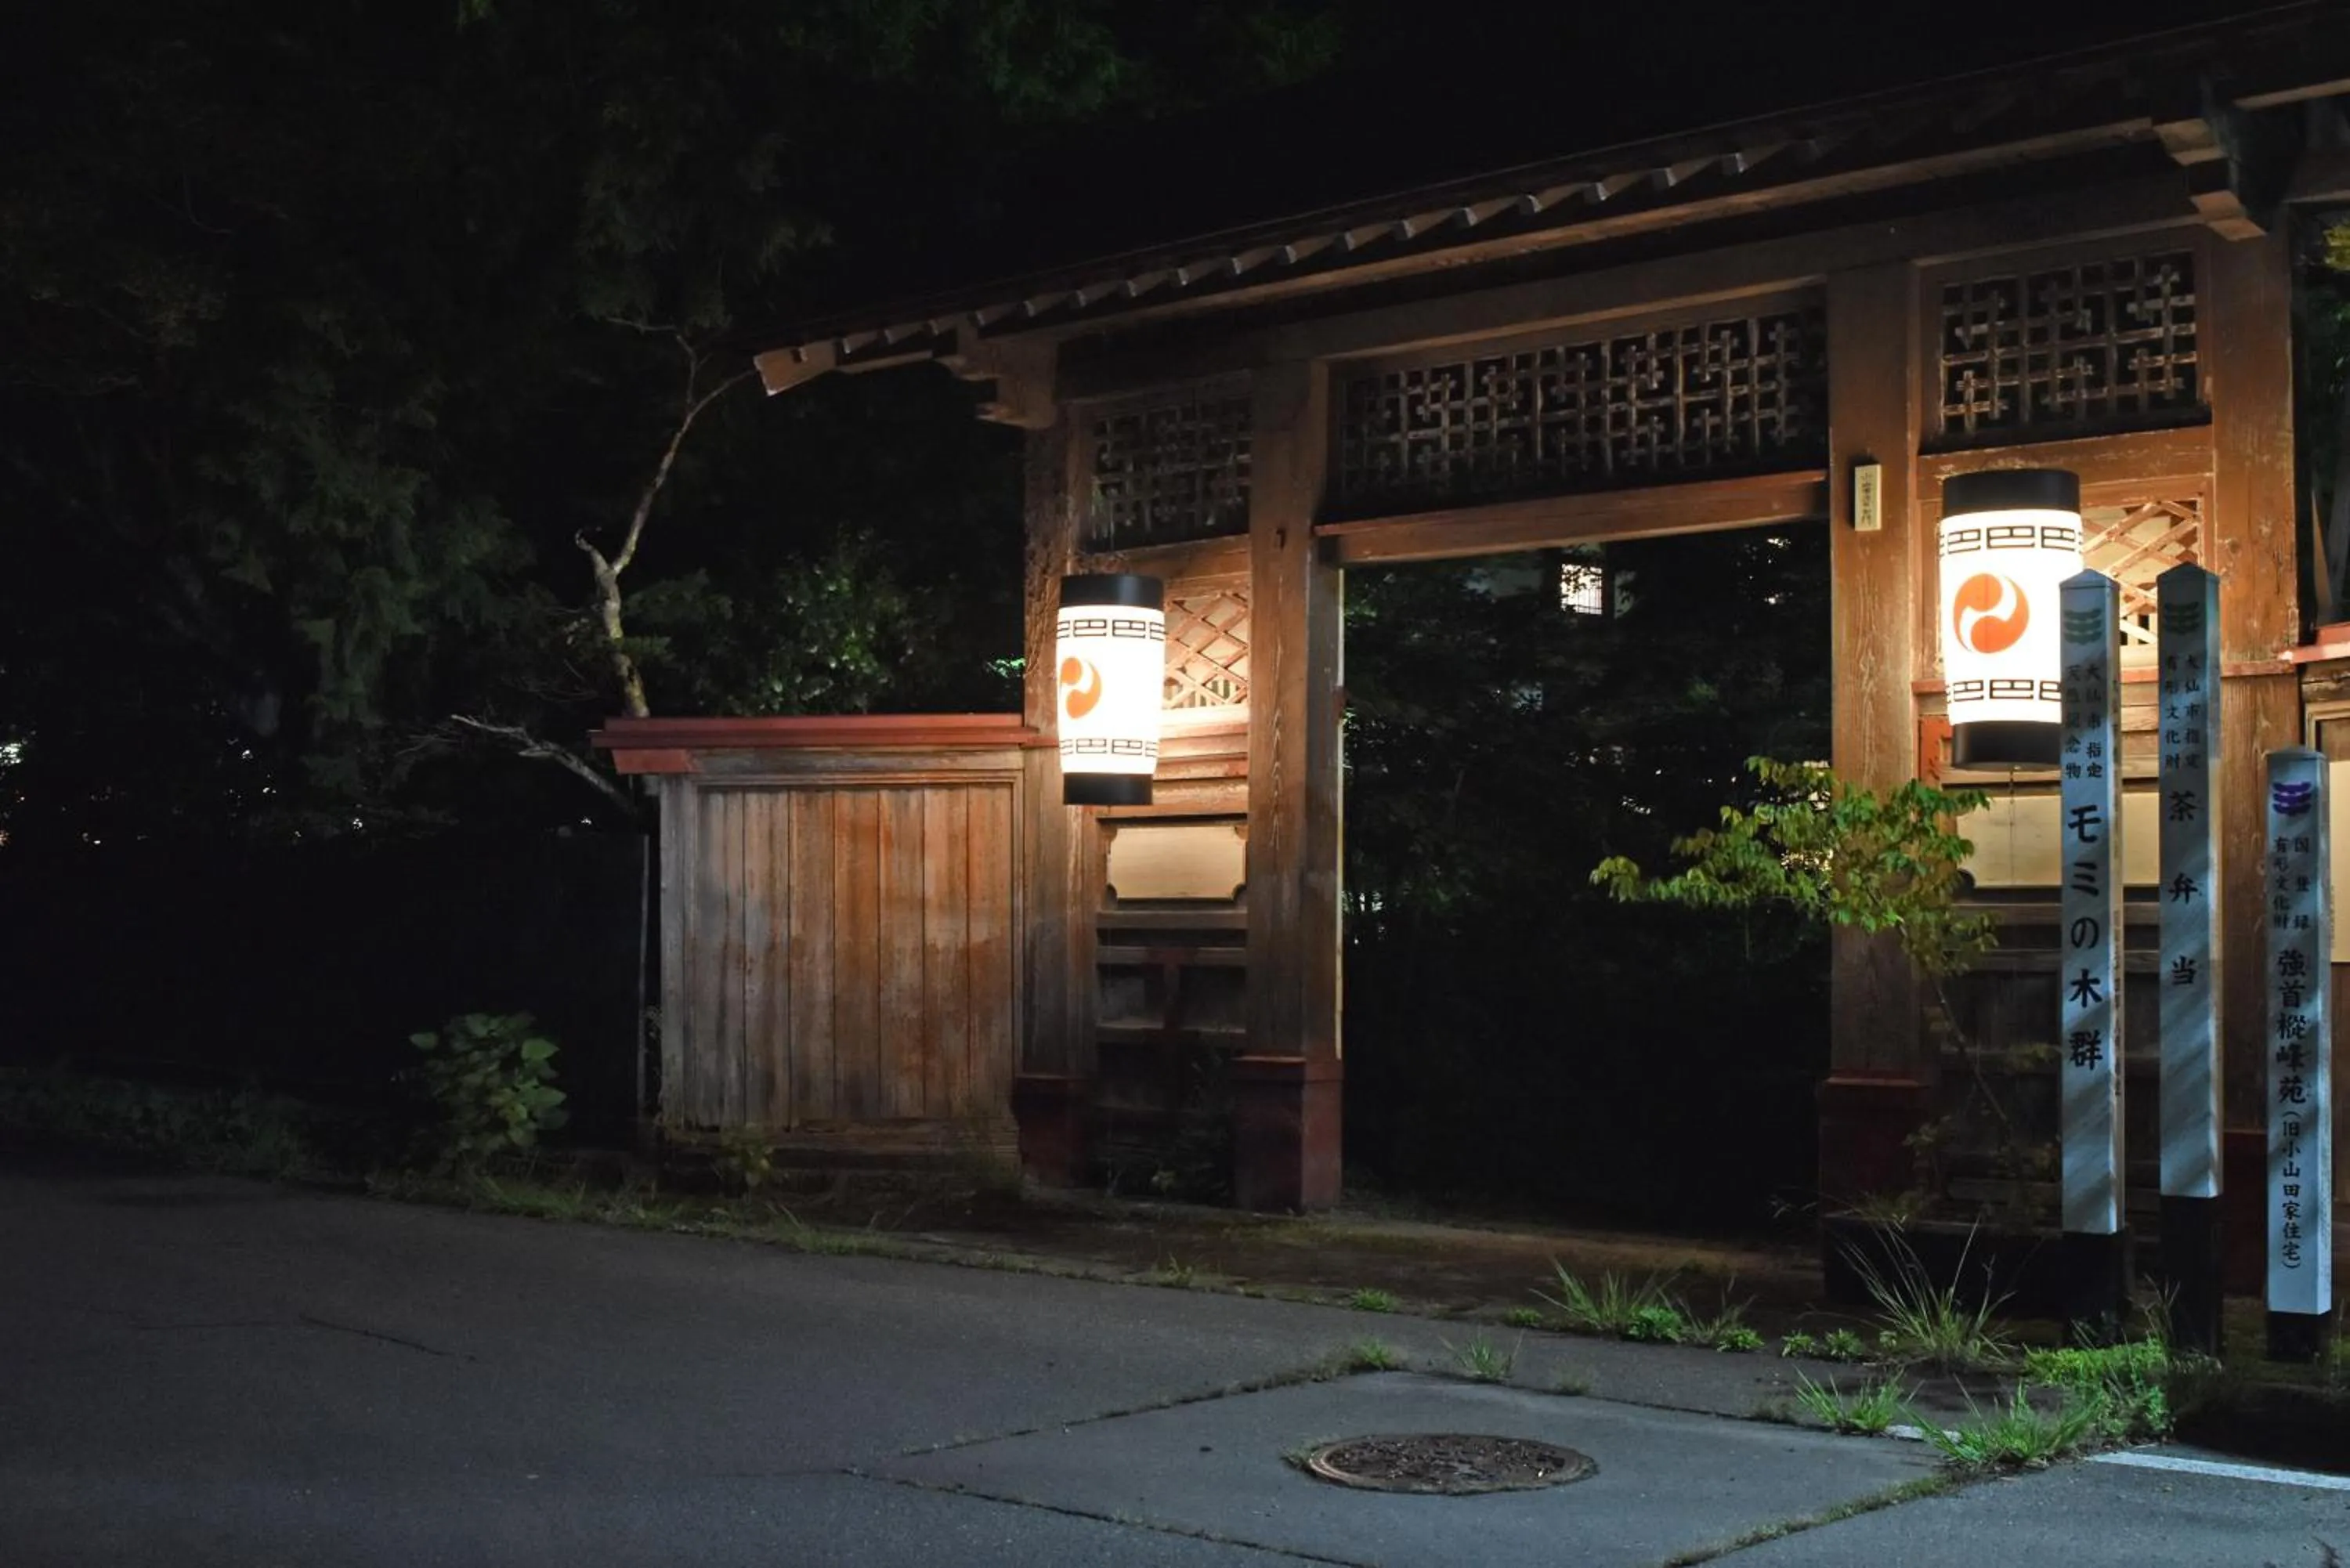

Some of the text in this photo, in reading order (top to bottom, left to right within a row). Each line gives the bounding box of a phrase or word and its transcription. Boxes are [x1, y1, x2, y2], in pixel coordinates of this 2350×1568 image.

[2067, 804, 2104, 1070] モミの木群
[2168, 791, 2197, 986] 茶弁当
